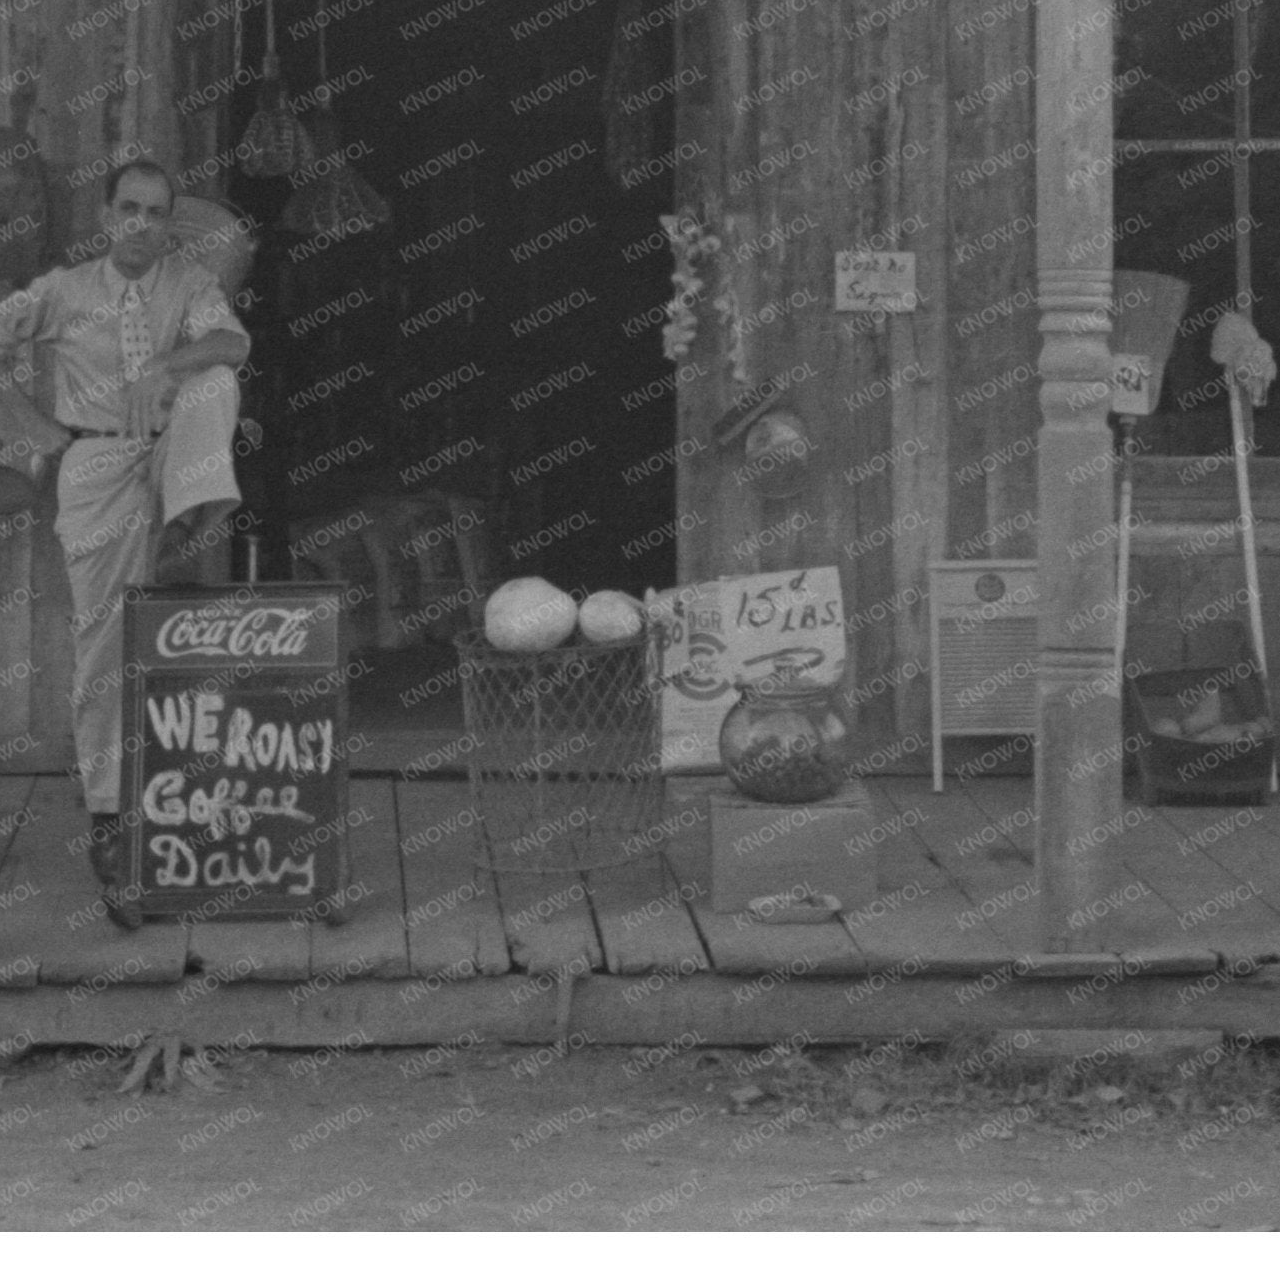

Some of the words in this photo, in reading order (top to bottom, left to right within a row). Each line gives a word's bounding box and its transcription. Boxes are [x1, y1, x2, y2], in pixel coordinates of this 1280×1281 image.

[156, 607, 315, 658] Coca-Cola
[147, 692, 224, 753] WE
[143, 770, 316, 840] Coffee
[149, 834, 316, 896] Daily
